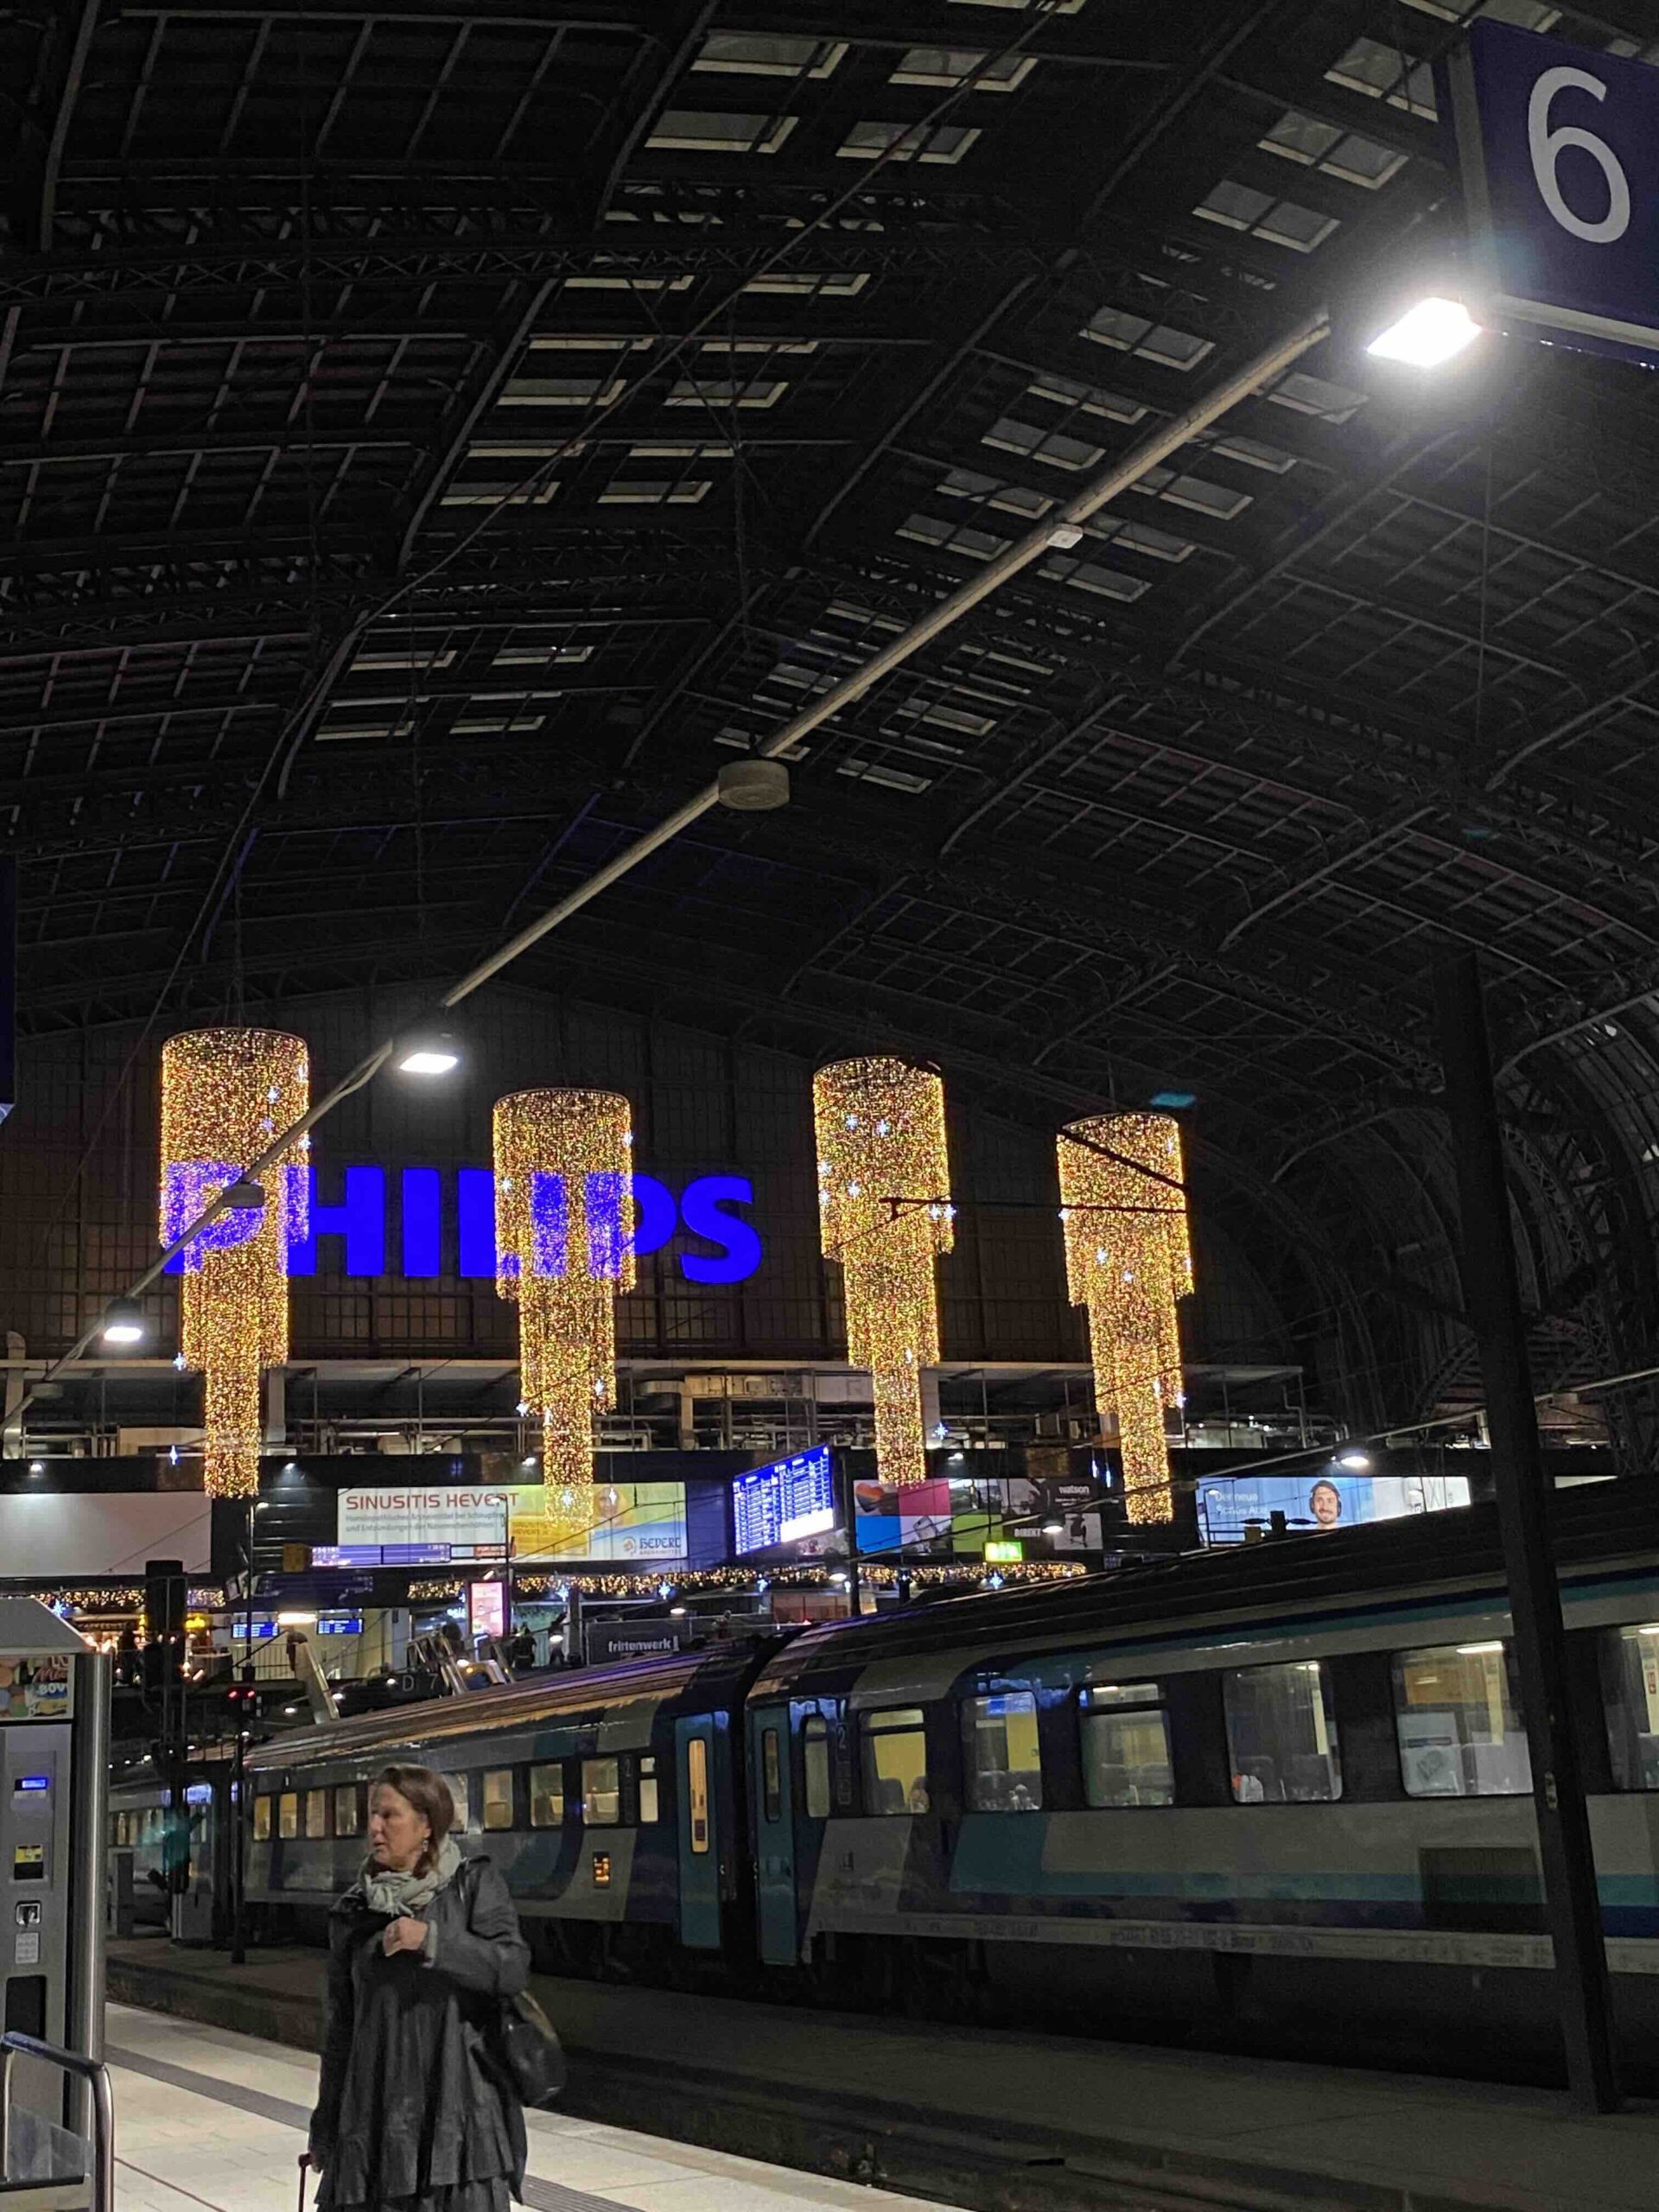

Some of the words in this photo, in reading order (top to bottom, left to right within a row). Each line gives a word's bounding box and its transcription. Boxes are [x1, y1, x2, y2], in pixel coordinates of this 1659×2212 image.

[1528, 66, 1630, 243] 6
[159, 1160, 761, 1284] PHILIPS
[1058, 1484, 1090, 1495] watson
[346, 1494, 441, 1510] SINUSITIS
[608, 1637, 671, 1652] frittenwerk
[403, 1675, 415, 1692] D
[429, 1673, 438, 1689] 7
